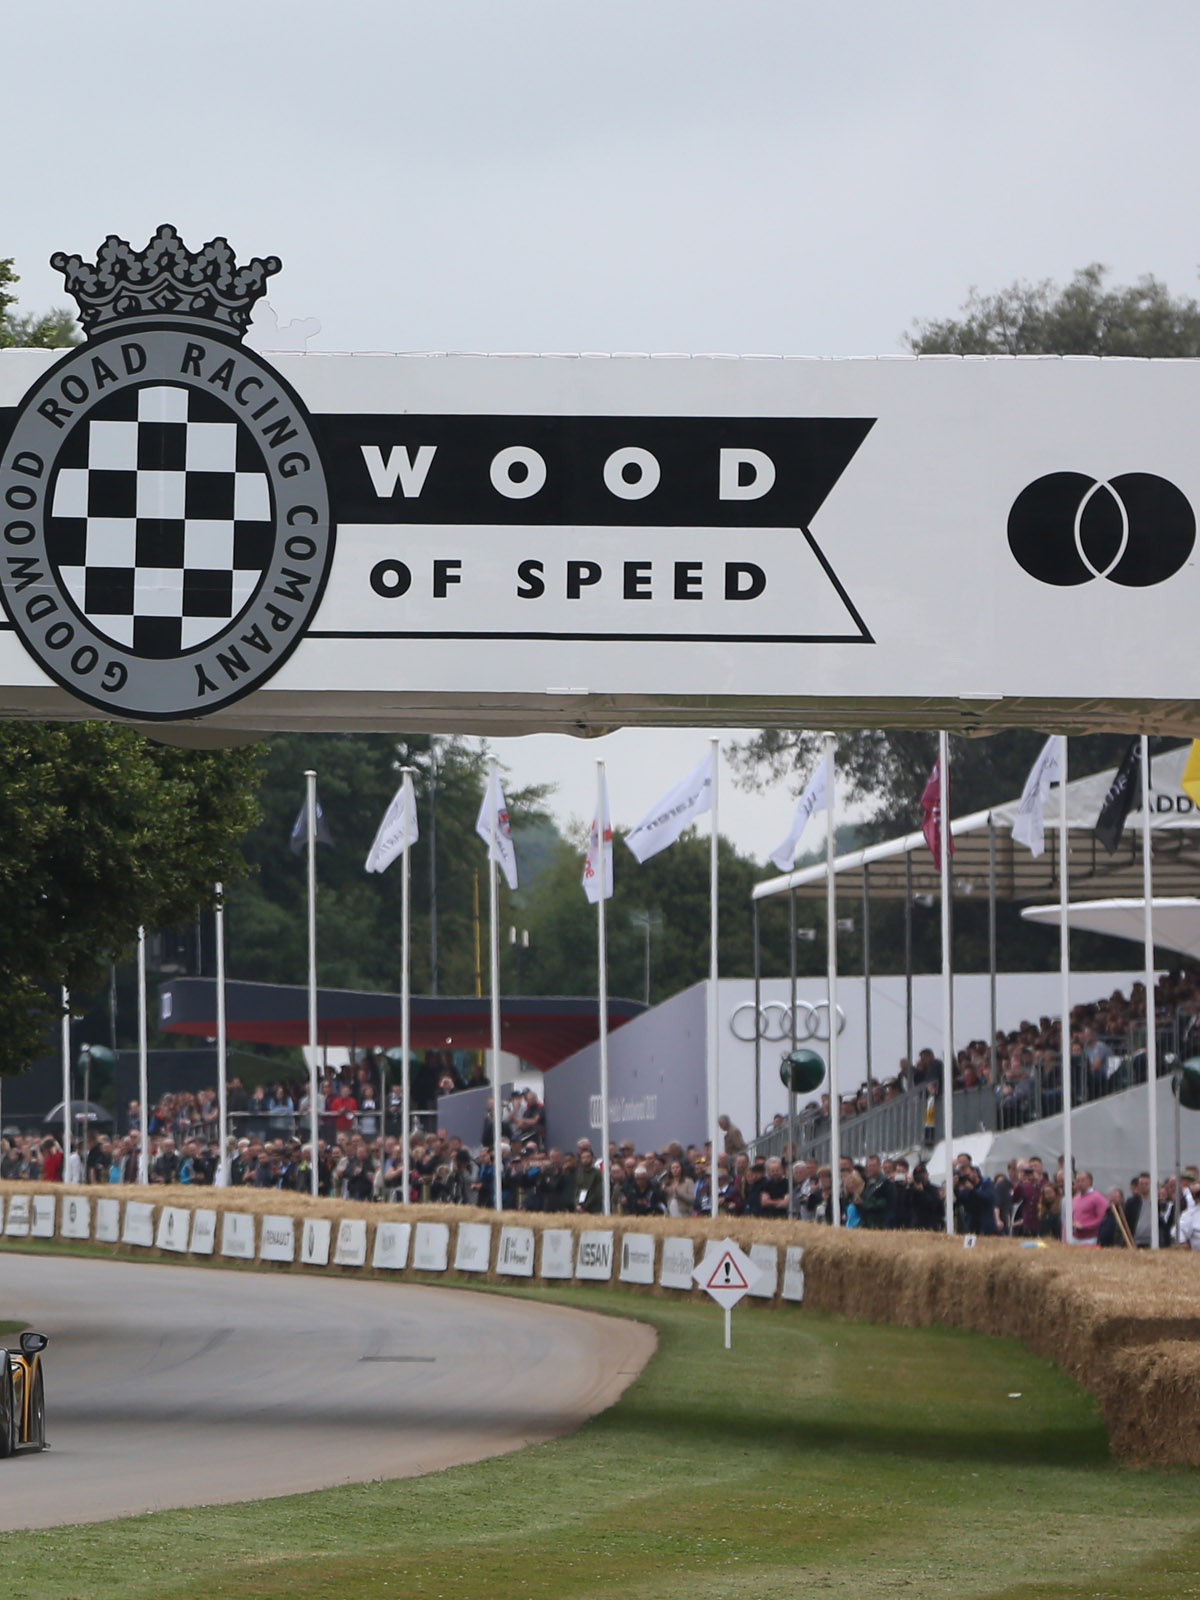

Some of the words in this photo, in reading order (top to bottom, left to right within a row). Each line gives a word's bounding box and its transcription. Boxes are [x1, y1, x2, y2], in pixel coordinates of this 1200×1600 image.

[37, 342, 148, 429] ROAD
[180, 342, 311, 480] RACING
[360, 445, 776, 500] WOOD
[194, 504, 319, 697] COMPANY
[369, 559, 463, 599] OF
[516, 559, 767, 600] SPEED
